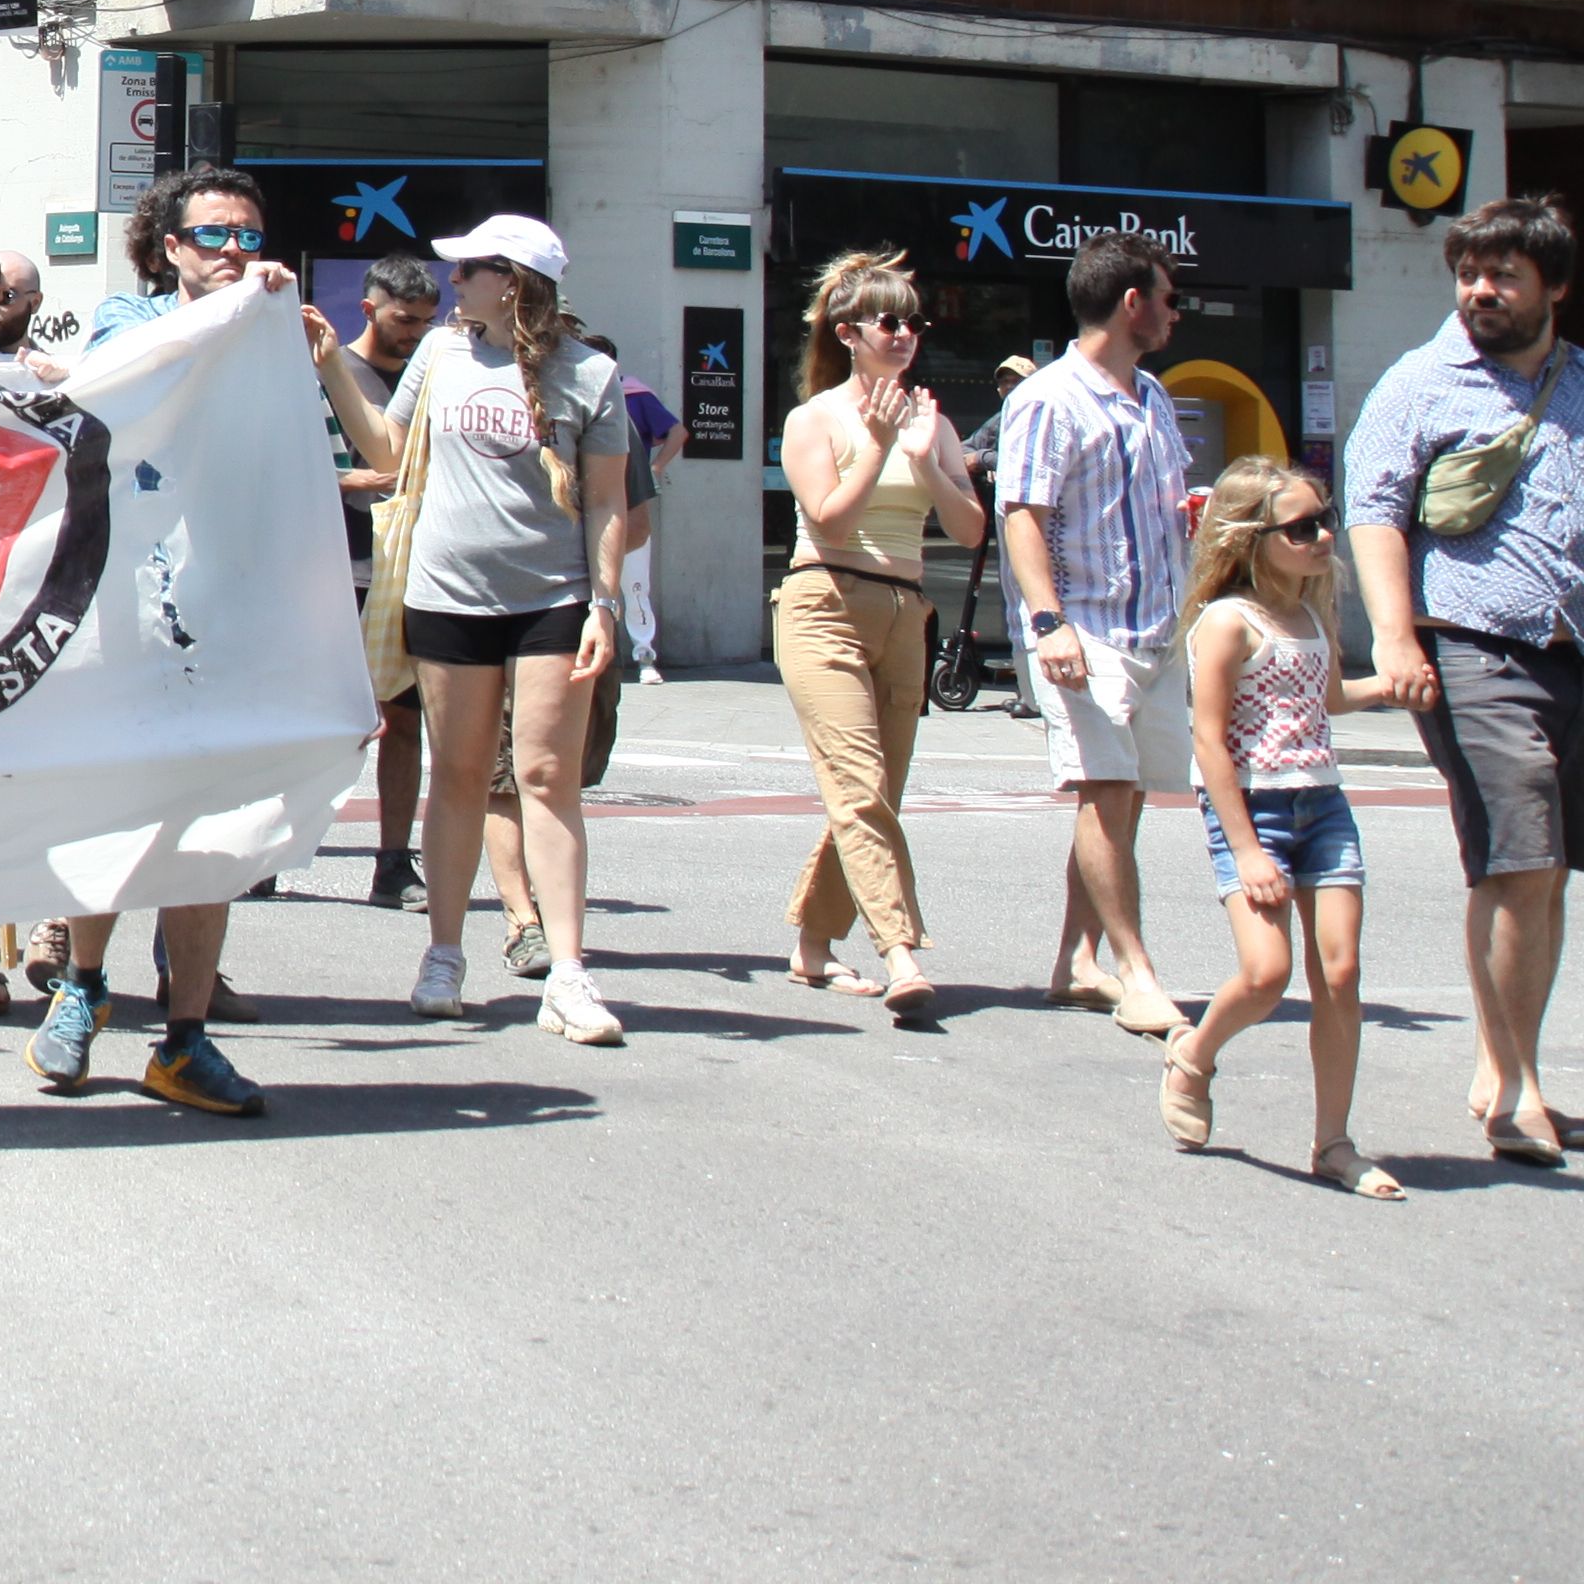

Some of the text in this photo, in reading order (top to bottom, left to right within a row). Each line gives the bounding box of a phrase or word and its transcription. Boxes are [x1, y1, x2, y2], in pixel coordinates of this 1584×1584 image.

[118, 56, 142, 66] AMB
[121, 76, 146, 86] Zona
[126, 87, 155, 97] Emiss
[692, 247, 701, 255] de
[32, 311, 80, 343] ACAB
[691, 374, 736, 387] CaixaBank
[698, 402, 729, 415] Store
[692, 419, 735, 431] Cerdanyola
[695, 431, 708, 439] del
